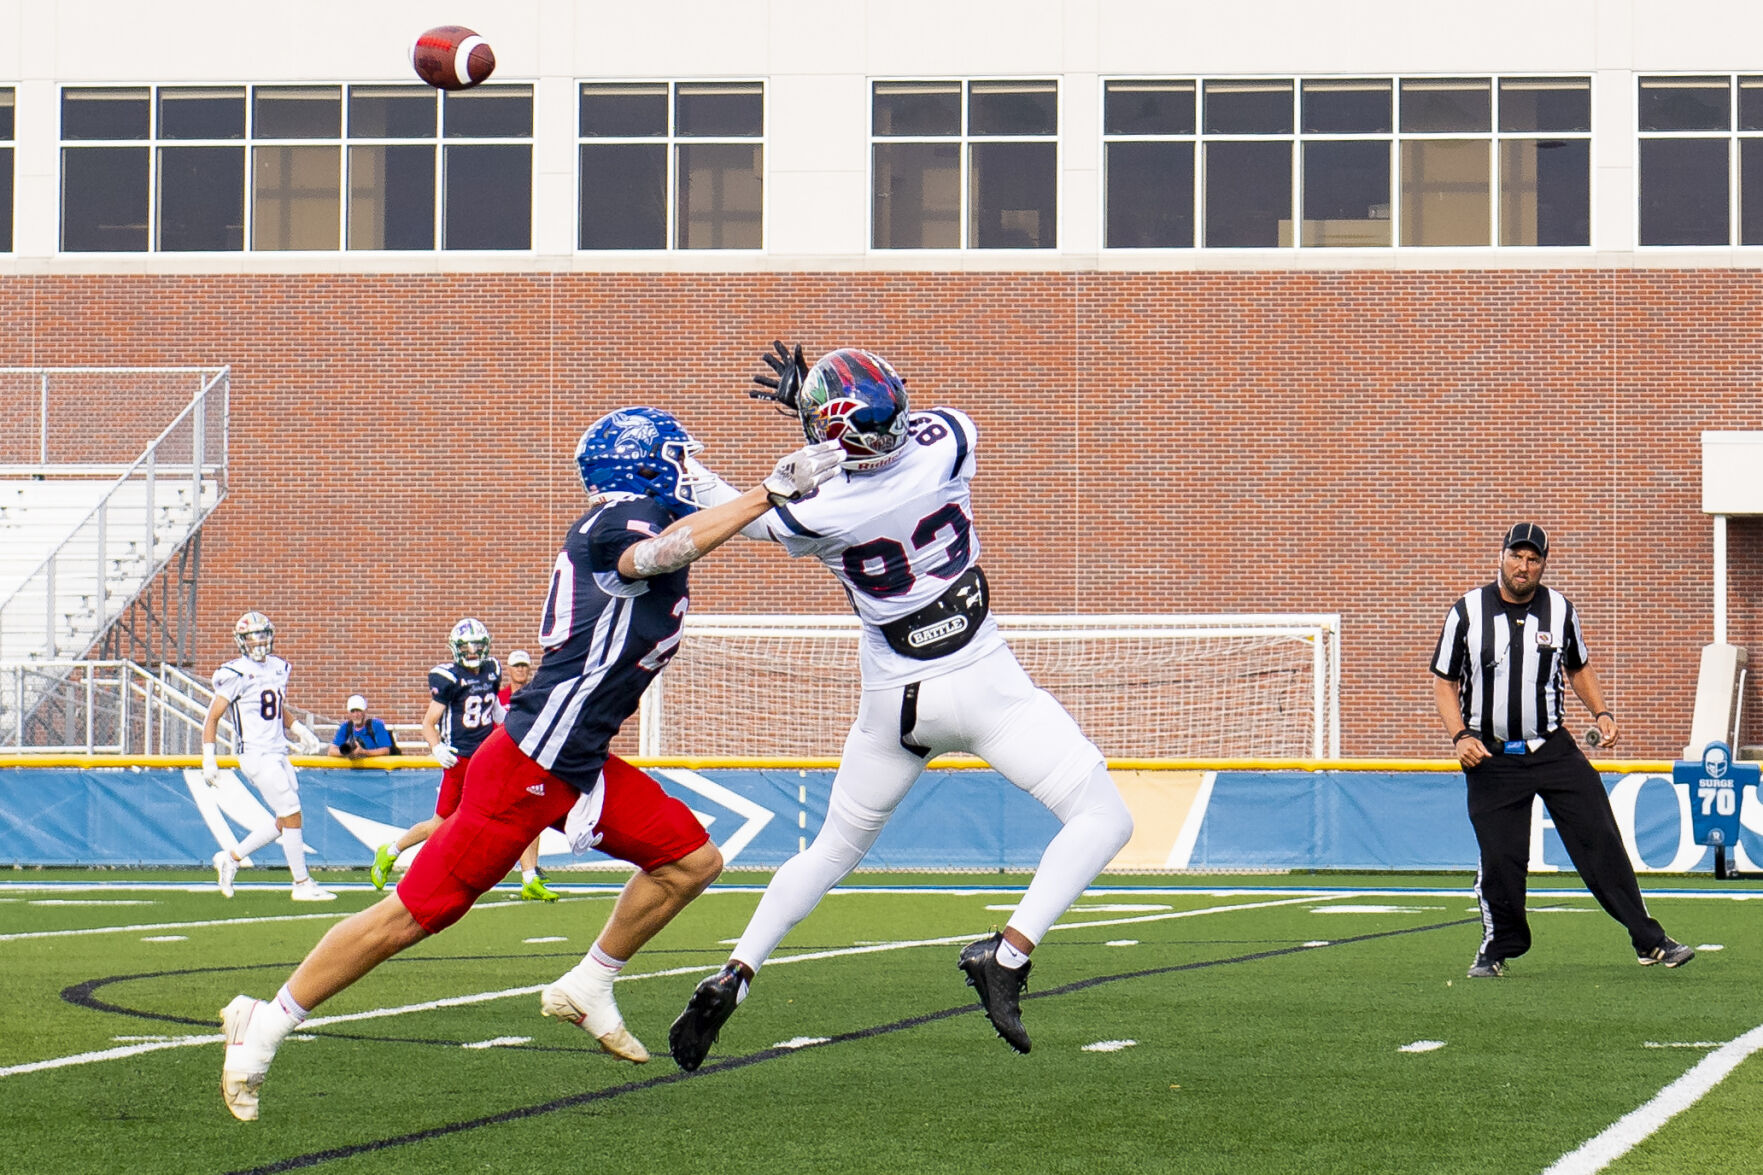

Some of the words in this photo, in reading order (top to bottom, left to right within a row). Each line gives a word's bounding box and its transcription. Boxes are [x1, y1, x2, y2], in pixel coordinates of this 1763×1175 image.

[912, 618, 964, 644] BATTLE
[260, 688, 283, 721] 81
[462, 692, 496, 729] 82
[1698, 779, 1735, 788] SURGE
[1697, 788, 1736, 816] 70
